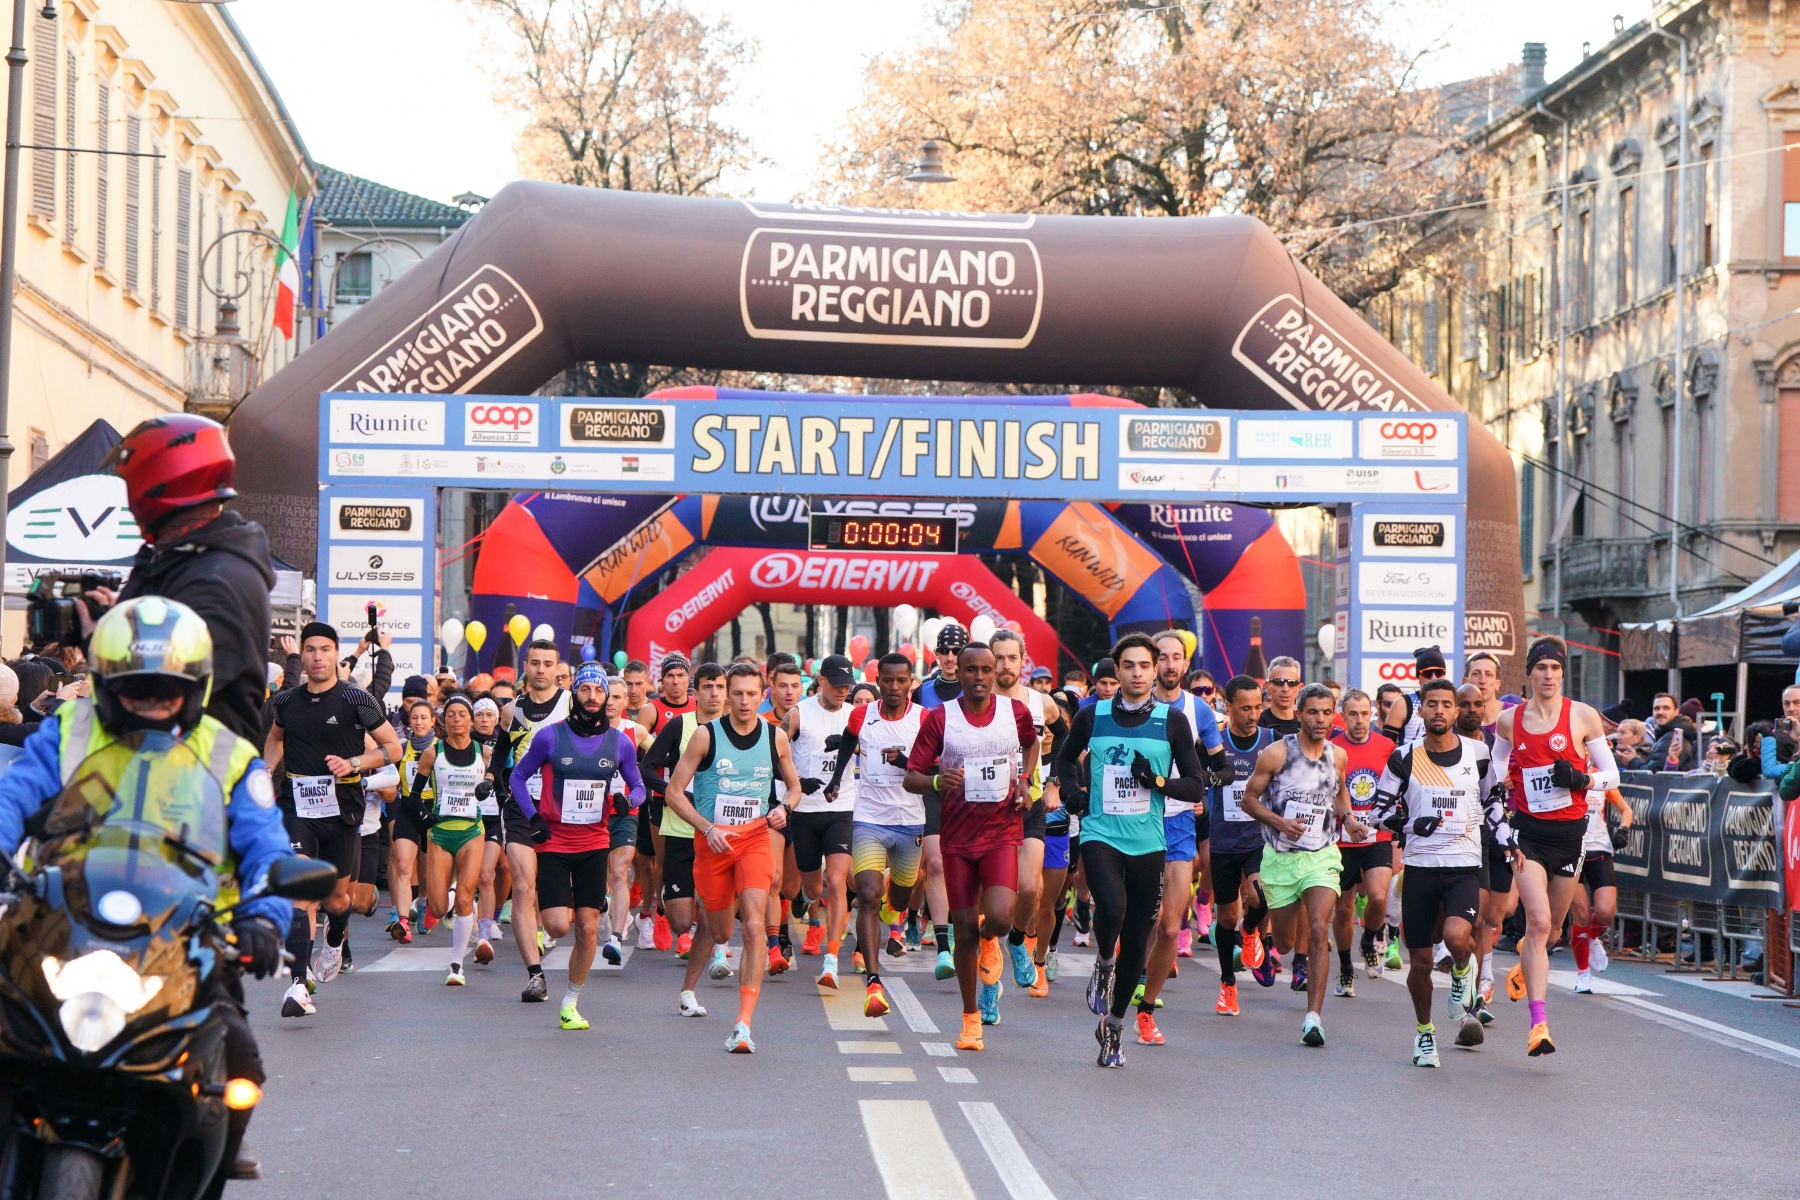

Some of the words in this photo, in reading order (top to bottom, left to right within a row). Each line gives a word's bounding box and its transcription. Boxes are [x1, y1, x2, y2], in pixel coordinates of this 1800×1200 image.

[770, 241, 1016, 288] PARMIGIANO
[791, 283, 991, 328] REGGIANO
[1273, 308, 1417, 412] PARMIGIAN
[1266, 342, 1361, 411] REGGIA
[349, 412, 428, 436] Riunite
[471, 405, 533, 430] coop
[577, 411, 658, 425] PARMIGIANO
[471, 433, 505, 441] Alleanza
[585, 425, 650, 438] REGGIANO
[1134, 422, 1215, 438] PARMIGIANO
[1380, 422, 1437, 444] coop
[691, 413, 1101, 480] START/FINISH
[1141, 435, 1207, 450] REGGIANO
[1381, 447, 1412, 455] Alleanza
[1141, 475, 1166, 483] IAAF
[551, 492, 592, 504] Lambrusco
[594, 496, 601, 505] ci
[602, 498, 627, 507] unisce
[344, 506, 407, 518] PARMIGIANO
[1149, 502, 1233, 528] Riunite
[350, 517, 401, 528] REGGIANO
[1378, 523, 1440, 535] PARMIGIANO
[844, 521, 941, 545] 0:00:04
[1208, 532, 1233, 541] unisce
[1384, 533, 1434, 545] REGGIANO
[336, 571, 415, 581] ULYSSES
[797, 556, 940, 592] ENERVIT
[1383, 572, 1411, 585] Ford
[682, 568, 735, 621] ENERVIT
[966, 595, 1008, 628] ENER
[341, 620, 410, 631] coopervice
[1368, 619, 1447, 643] Riunite
[1465, 616, 1508, 632] IGIANO
[1379, 663, 1419, 680] coo
[980, 766, 996, 780] 15
[1114, 777, 1139, 789] PACER
[300, 786, 328, 798] GANASSI
[575, 790, 595, 802] LOLLO
[1117, 791, 1126, 799] 13
[1233, 790, 1245, 801] BAT
[308, 798, 315, 806] 11
[578, 802, 583, 810] 6
[1431, 797, 1457, 810] NOUINI
[722, 805, 753, 819] FERRATO
[1437, 810, 1442, 818] 9
[1663, 801, 1707, 833] PARMIGIANO
[729, 818, 736, 826] 3
[1667, 834, 1702, 867] REGGIANO
